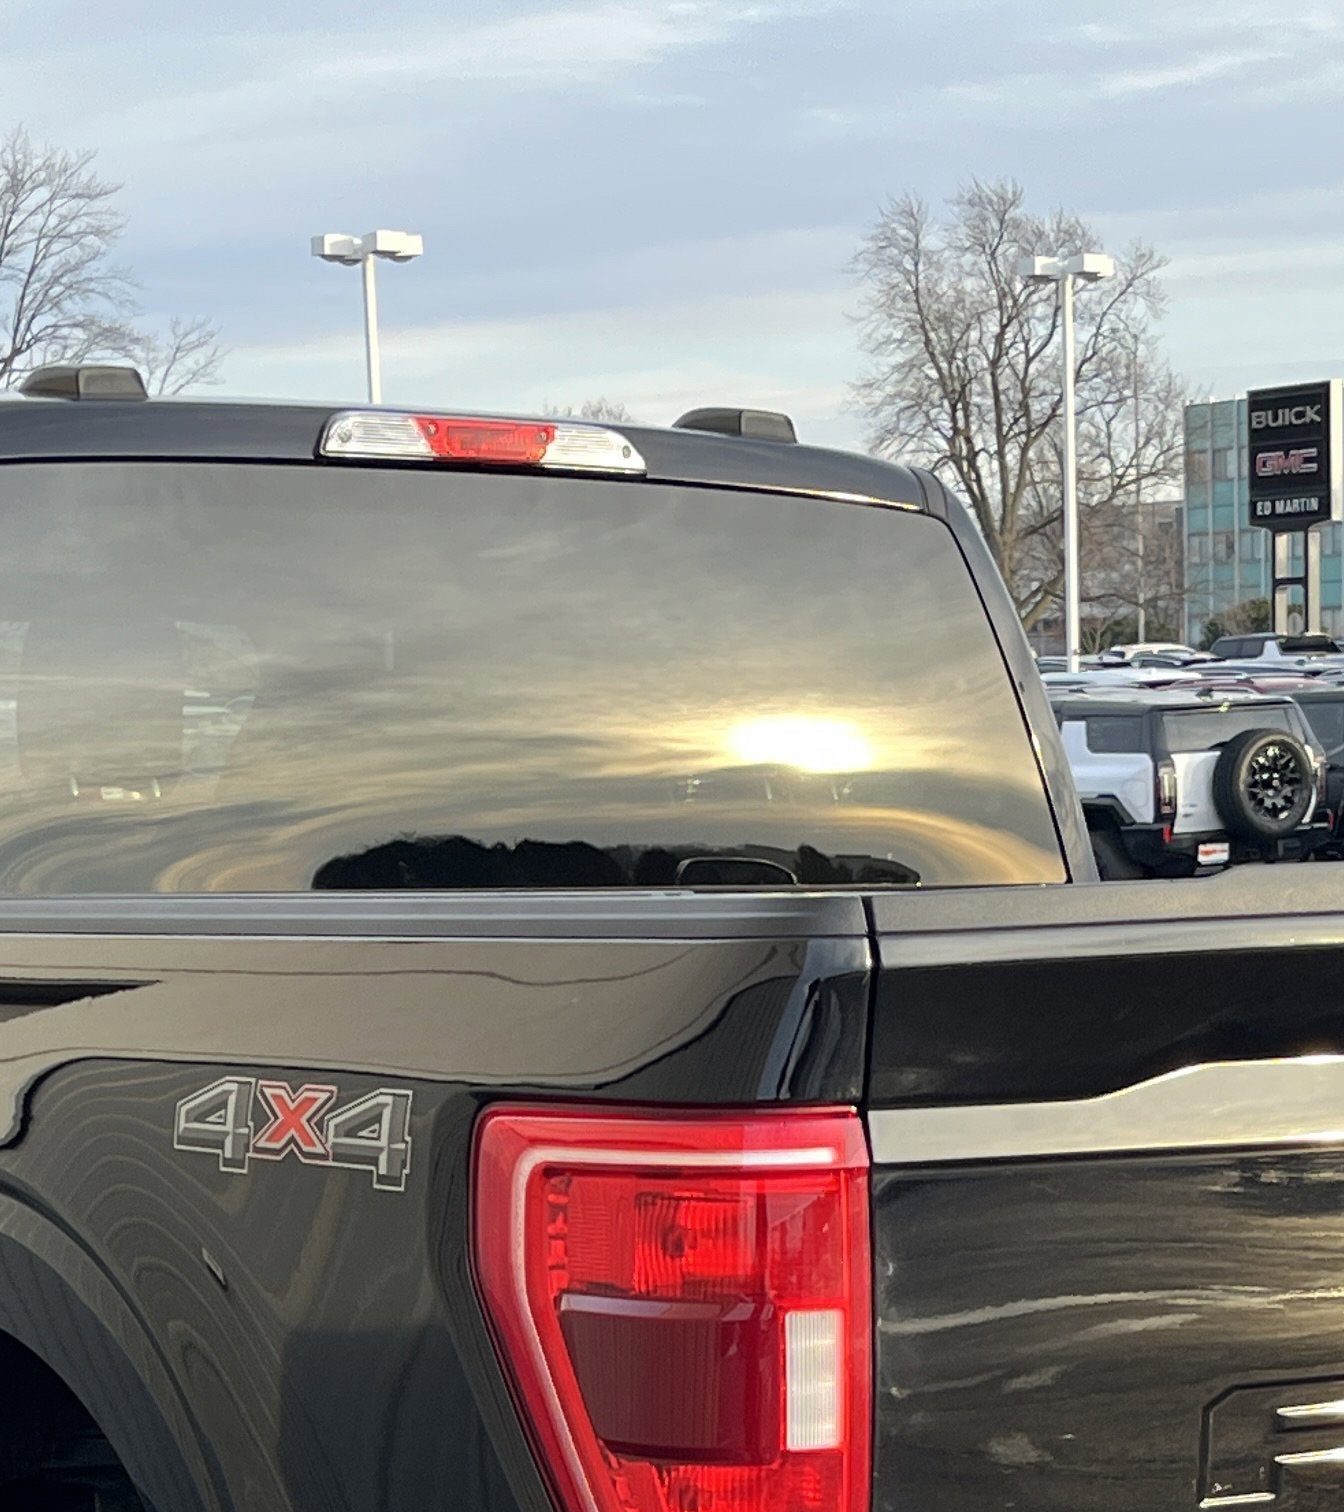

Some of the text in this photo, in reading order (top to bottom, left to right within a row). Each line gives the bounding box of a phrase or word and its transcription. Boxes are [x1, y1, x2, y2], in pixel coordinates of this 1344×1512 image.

[1252, 405, 1321, 428] BUICK
[1256, 448, 1318, 476] GMC
[1256, 497, 1319, 516] ED MARTIN
